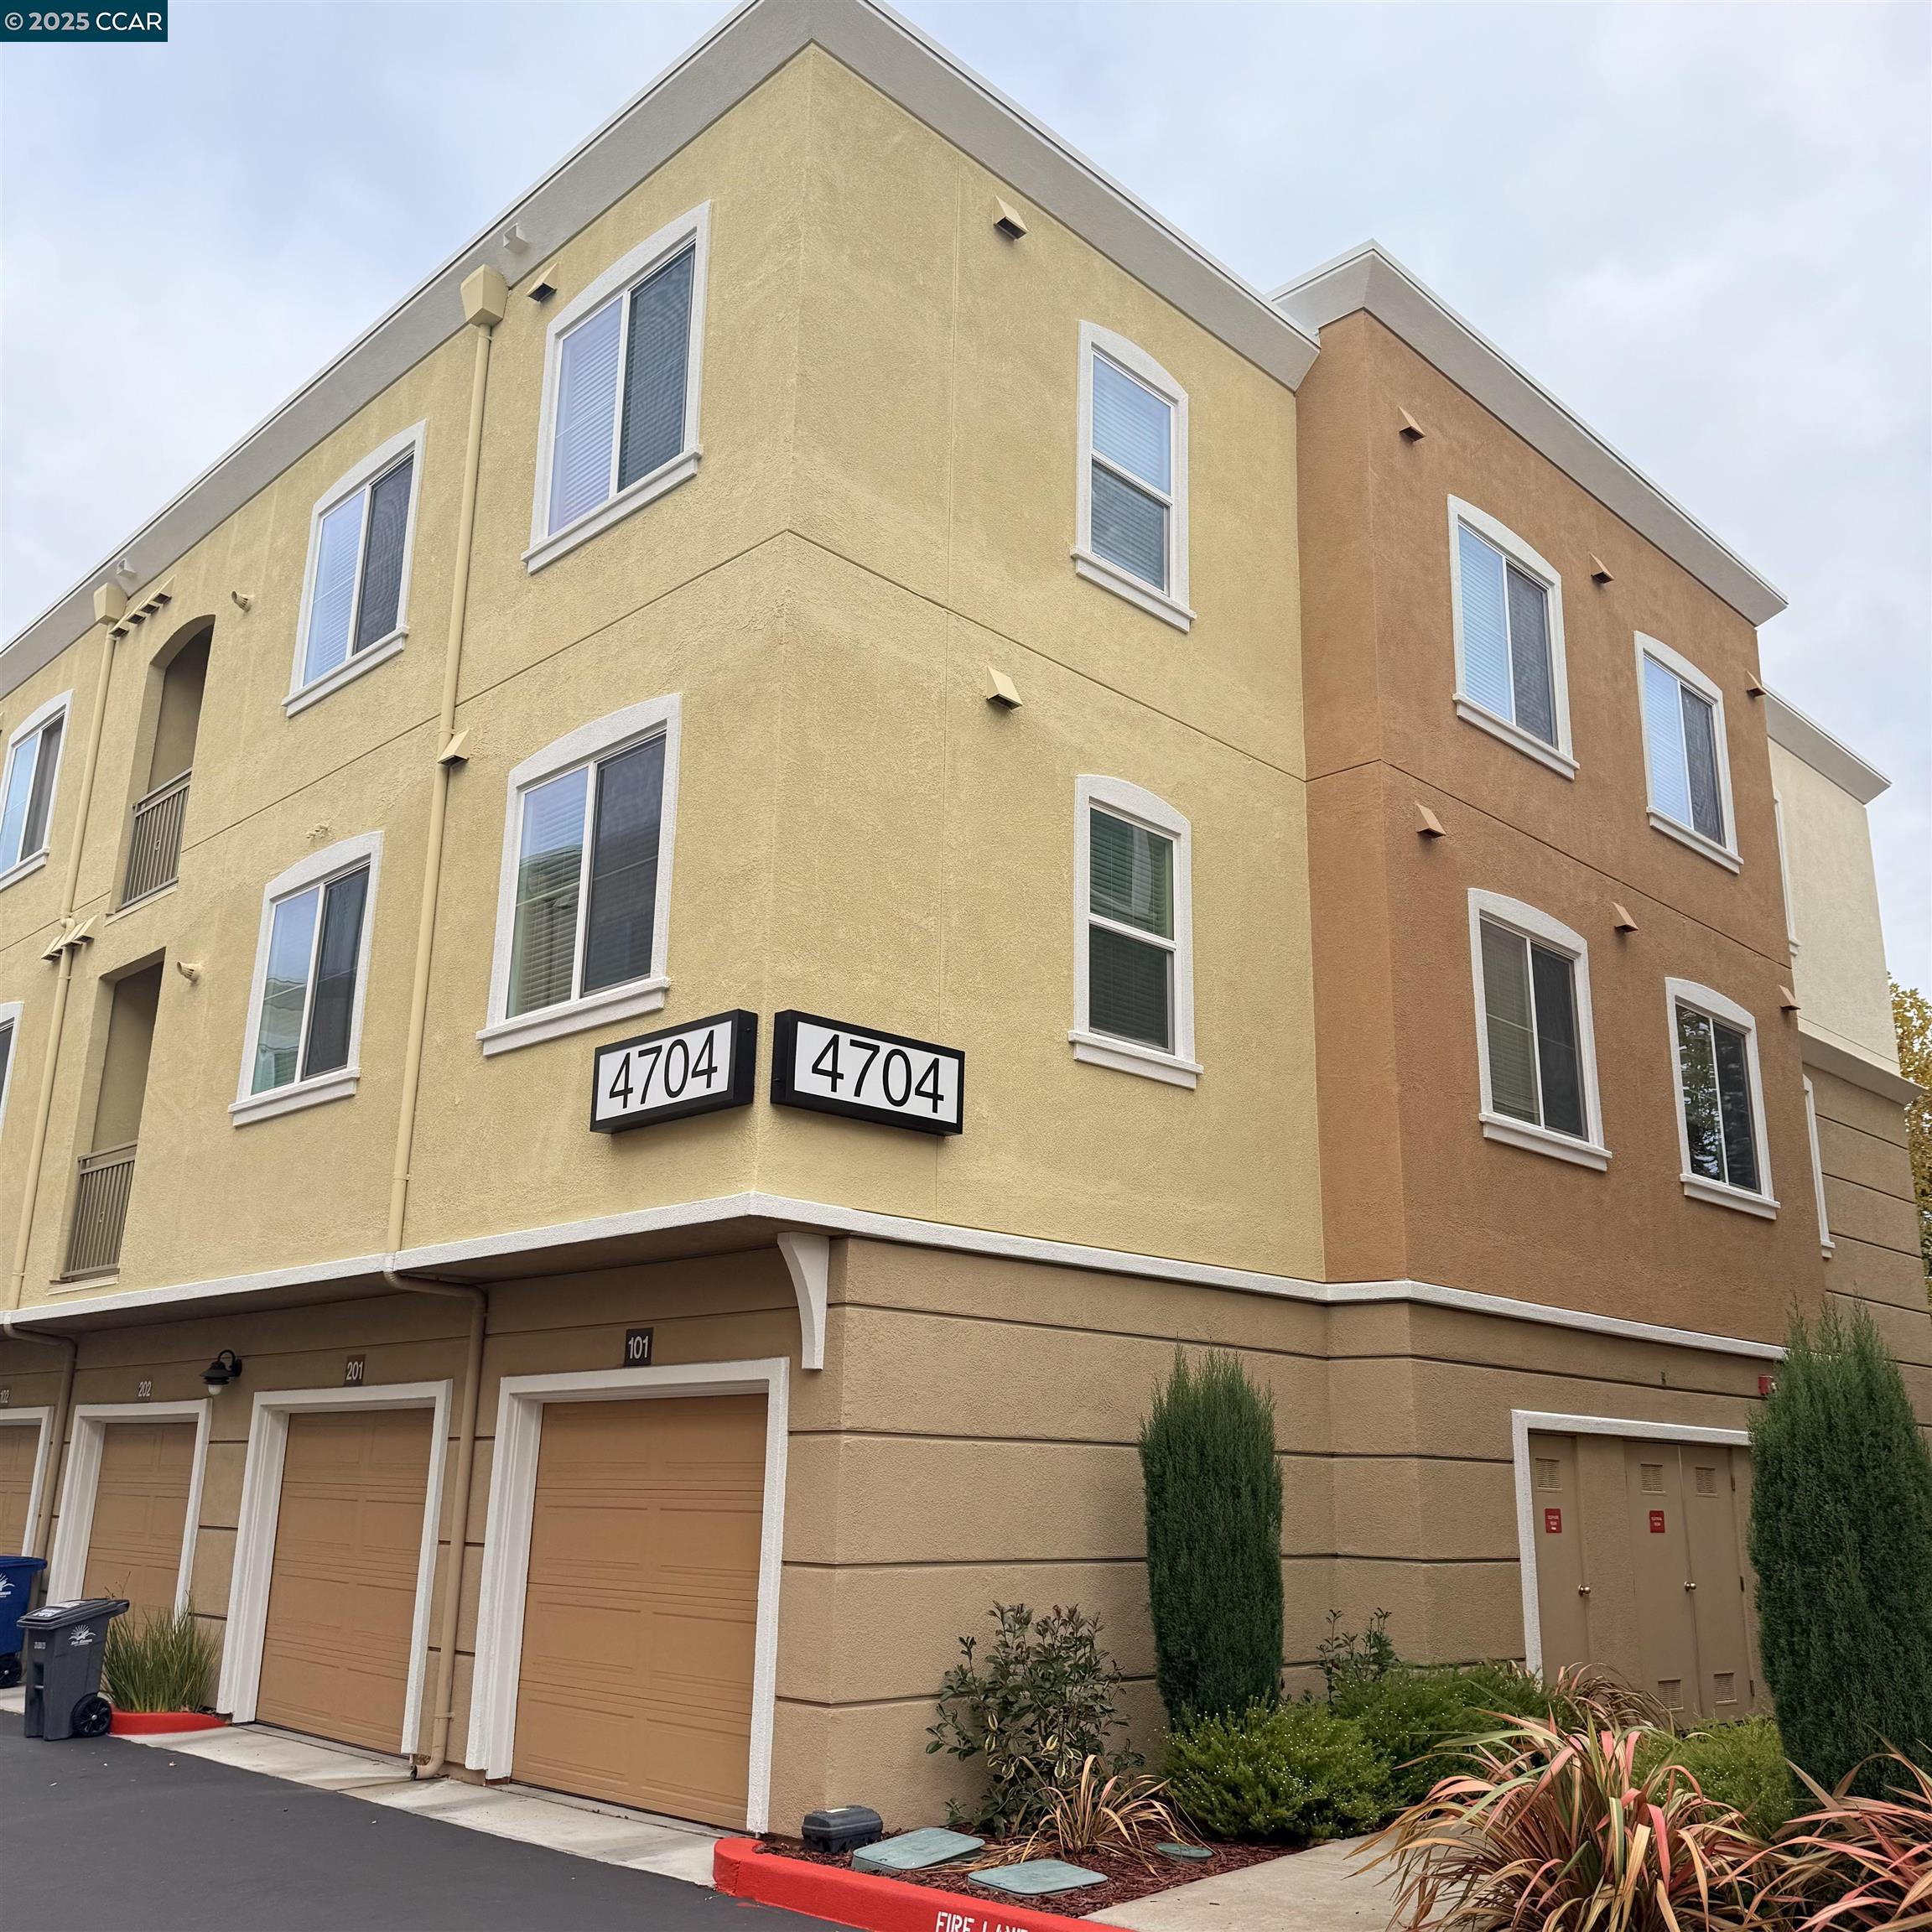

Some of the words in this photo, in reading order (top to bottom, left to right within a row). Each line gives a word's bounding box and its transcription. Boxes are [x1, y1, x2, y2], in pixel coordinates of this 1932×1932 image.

[609, 1029, 718, 1109] 4704
[811, 1033, 945, 1114] 4704
[628, 1335, 649, 1359] 101
[345, 1361, 363, 1380] 201
[138, 1381, 152, 1397] 202
